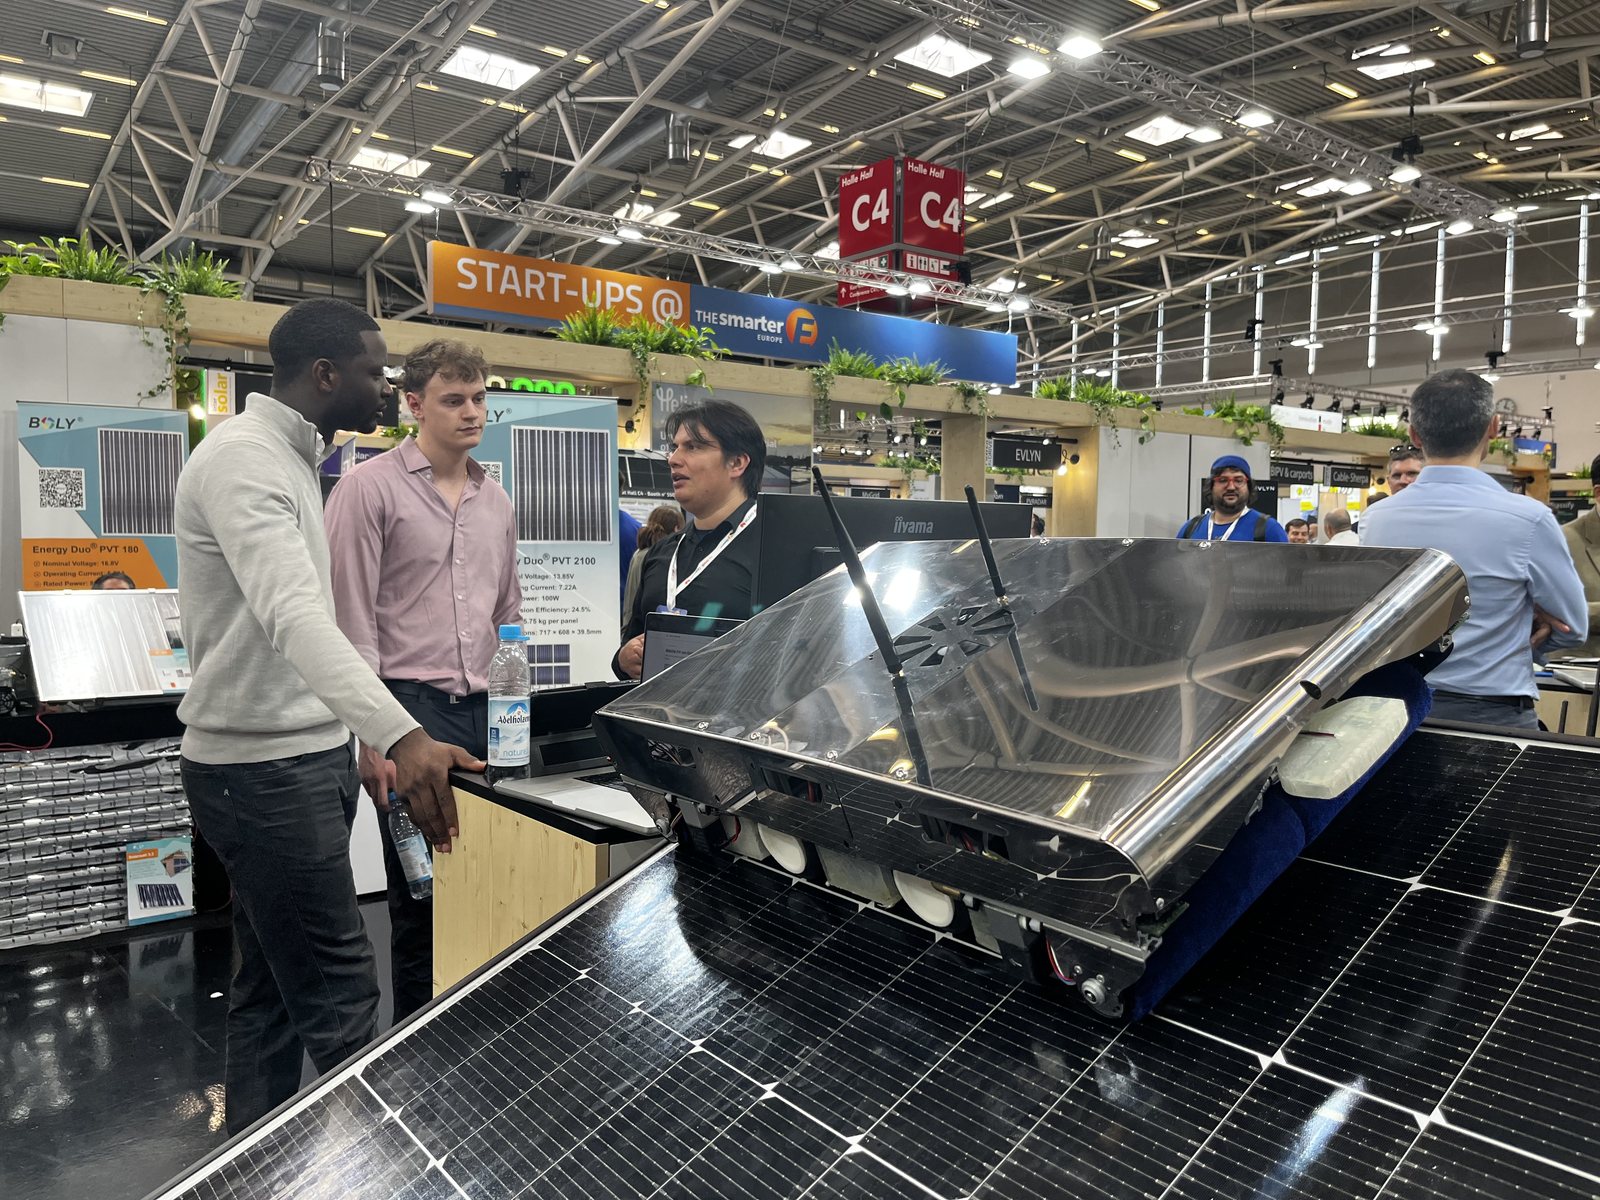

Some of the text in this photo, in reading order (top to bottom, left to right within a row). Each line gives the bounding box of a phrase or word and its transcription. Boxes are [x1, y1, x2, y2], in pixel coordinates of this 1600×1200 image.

[841, 167, 874, 187] Halle Hall
[907, 161, 945, 179] Halle Hall
[851, 188, 890, 232] C4
[920, 191, 961, 233] C4
[456, 257, 683, 326] START-UPS @
[757, 334, 783, 344] EUROPE
[1015, 448, 1041, 462] EVLYN
[893, 516, 934, 533] iiyama
[32, 545, 67, 555] Energy
[552, 557, 571, 565] PVT
[574, 557, 596, 565] 2100
